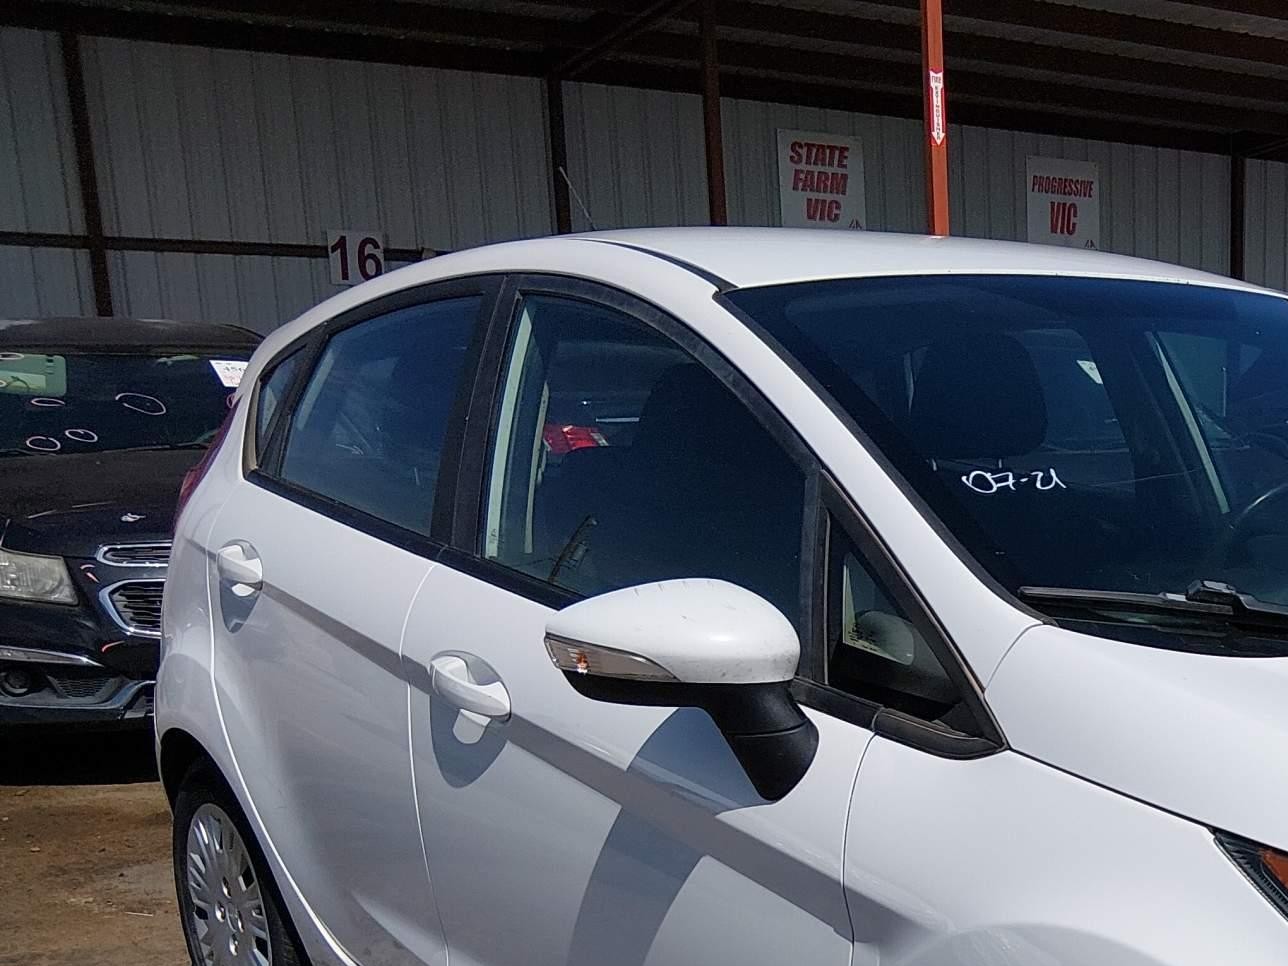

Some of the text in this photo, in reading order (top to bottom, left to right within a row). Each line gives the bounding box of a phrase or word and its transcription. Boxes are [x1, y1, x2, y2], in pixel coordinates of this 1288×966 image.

[789, 141, 849, 169] STATE
[792, 168, 848, 195] FARM
[1031, 175, 1094, 198] PROGRESSIVE
[806, 198, 841, 223] VIC
[1050, 201, 1078, 235] VIC
[330, 235, 383, 281] 16
